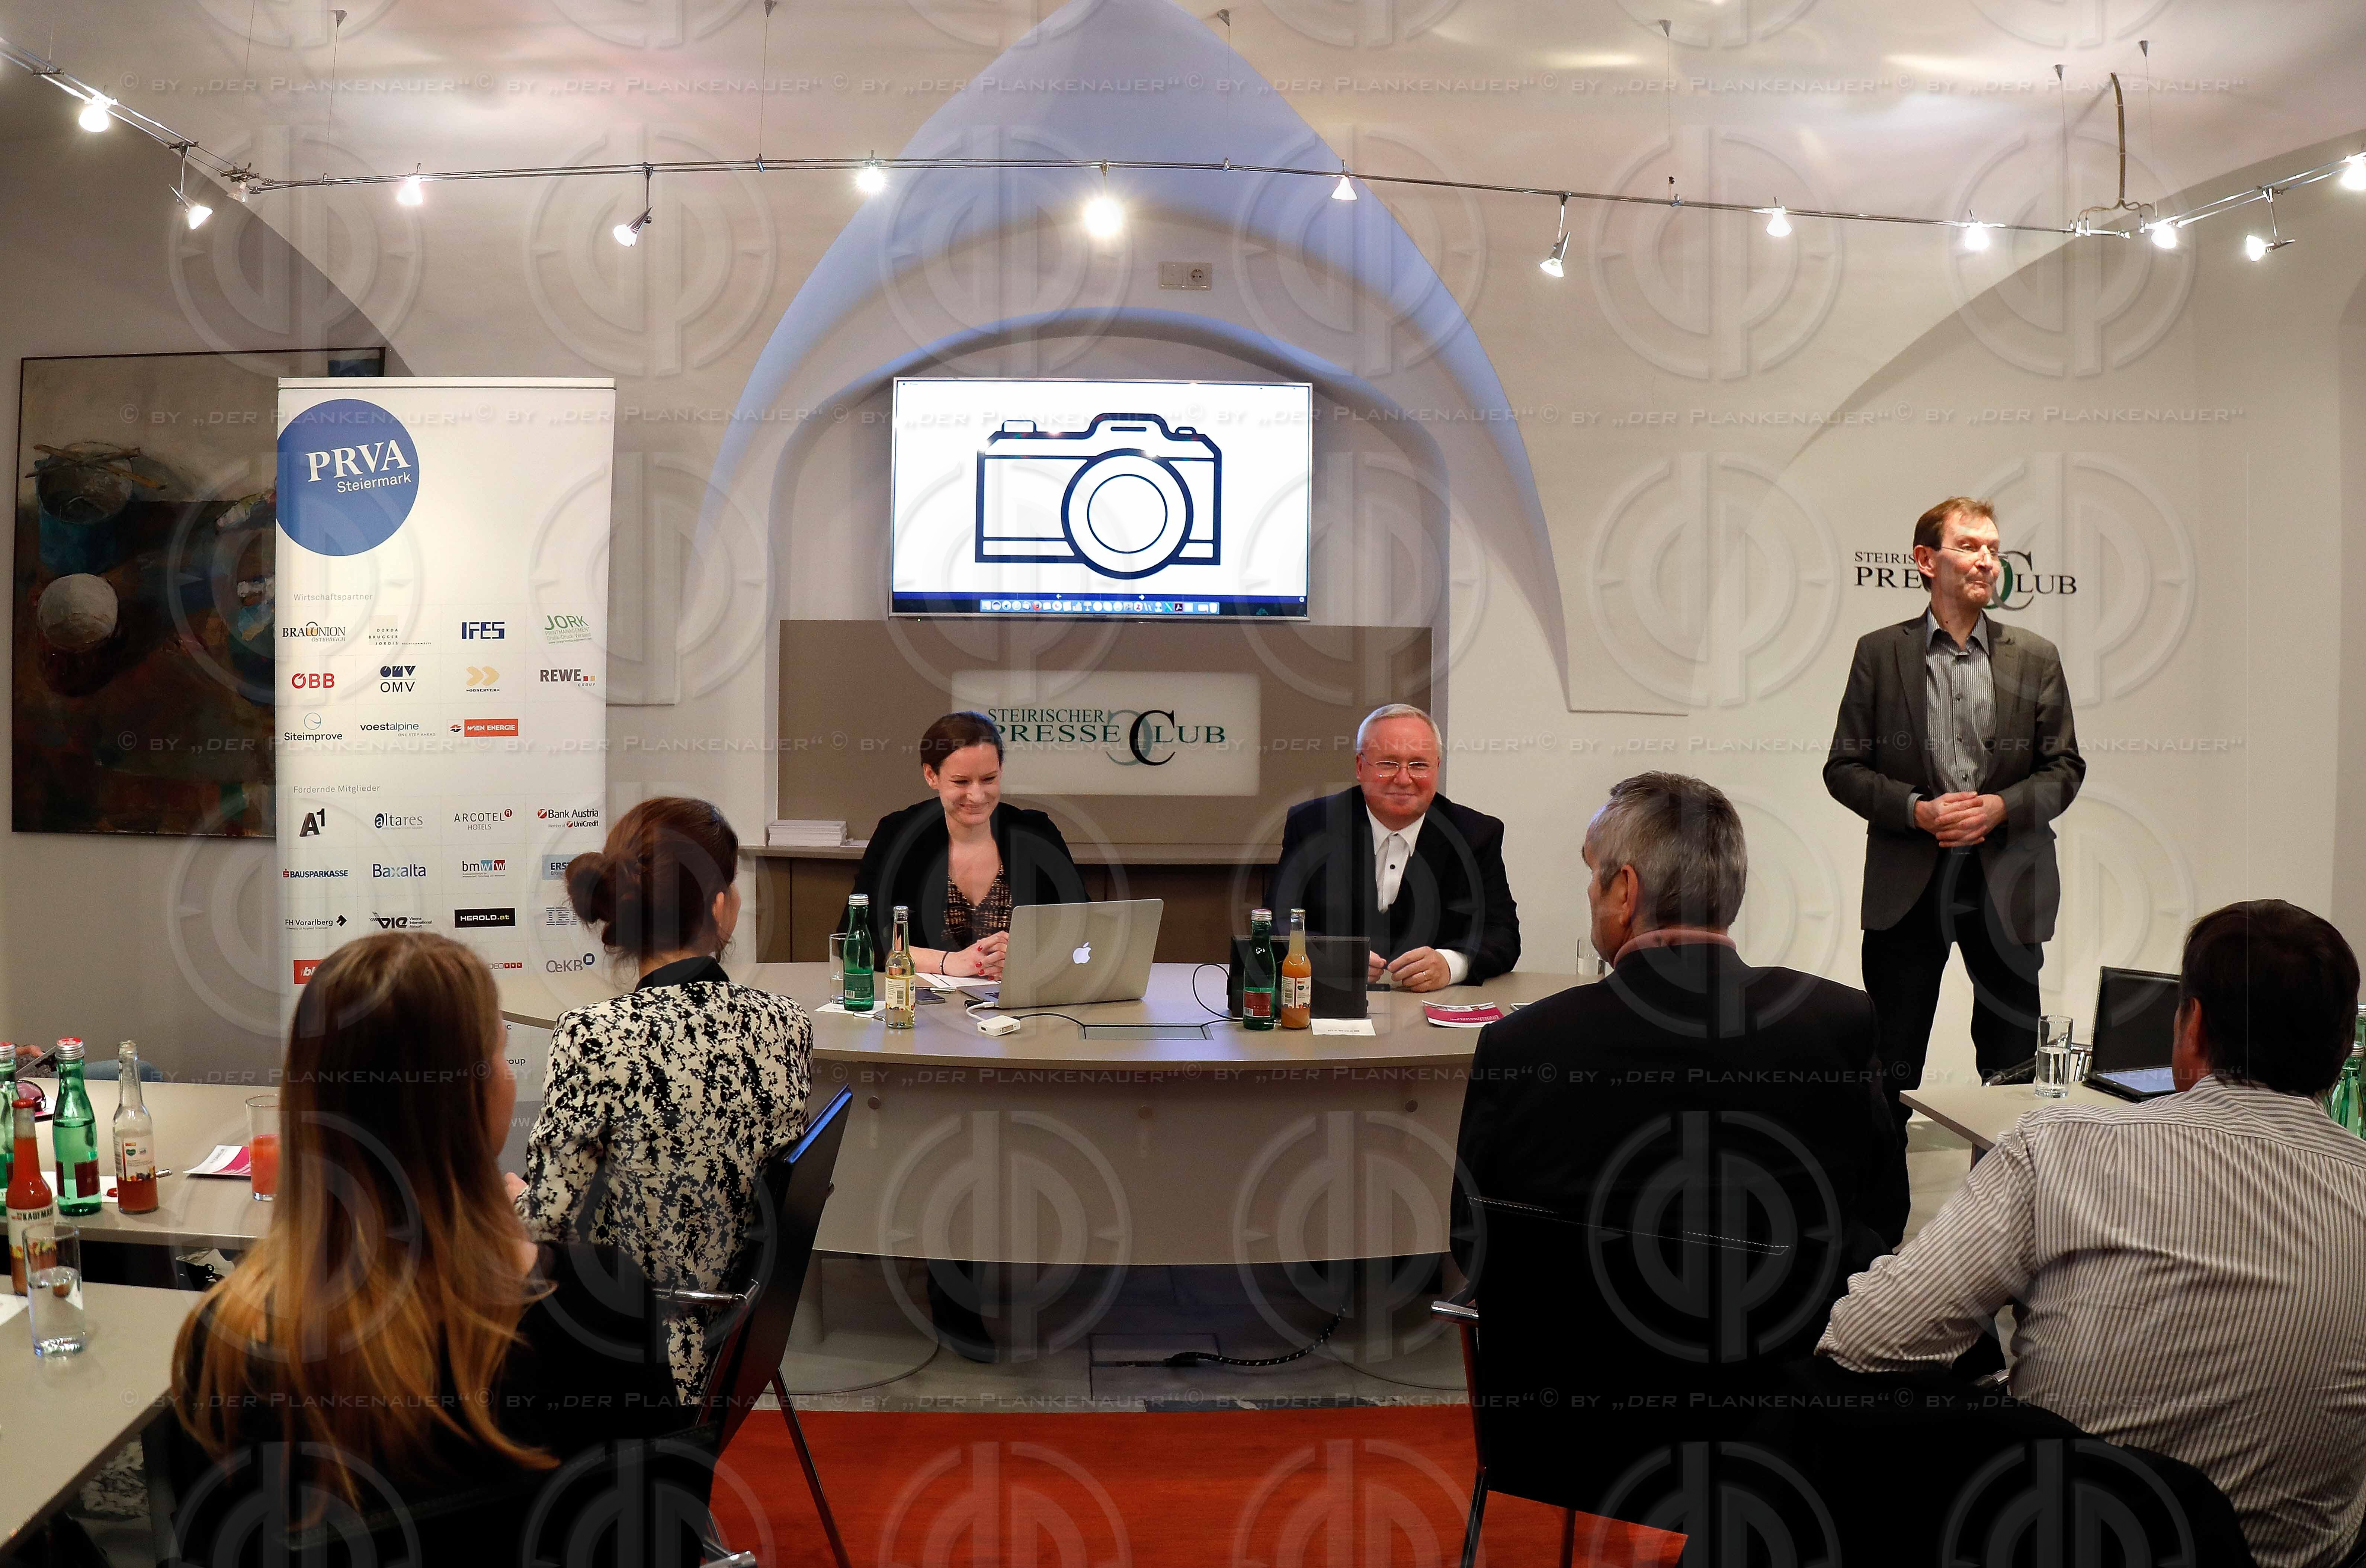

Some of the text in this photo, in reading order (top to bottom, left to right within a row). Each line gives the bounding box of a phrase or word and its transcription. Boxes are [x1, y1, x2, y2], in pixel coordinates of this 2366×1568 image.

[305, 439, 411, 482] PRVA
[337, 472, 411, 493] Steiermark
[545, 615, 589, 630] JORK
[462, 621, 505, 639] IFES
[291, 673, 335, 689] ÖBB
[540, 669, 581, 682] REWE
[380, 681, 416, 693] OMV
[988, 708, 1105, 723] STEIRISCHER
[360, 722, 419, 732] voestalpine
[284, 732, 343, 743] Siteimprove
[338, 785, 380, 794] Mitglieder
[454, 812, 505, 822] ARCOTEL
[548, 809, 599, 819] Bank Austria
[574, 820, 599, 828] UniCredit
[372, 863, 426, 878] Baxalta
[551, 862, 568, 870] ERS
[290, 870, 348, 878] BAUSPARKASSE
[295, 919, 333, 927] Vorarlberg
[546, 960, 583, 973] OeKB
